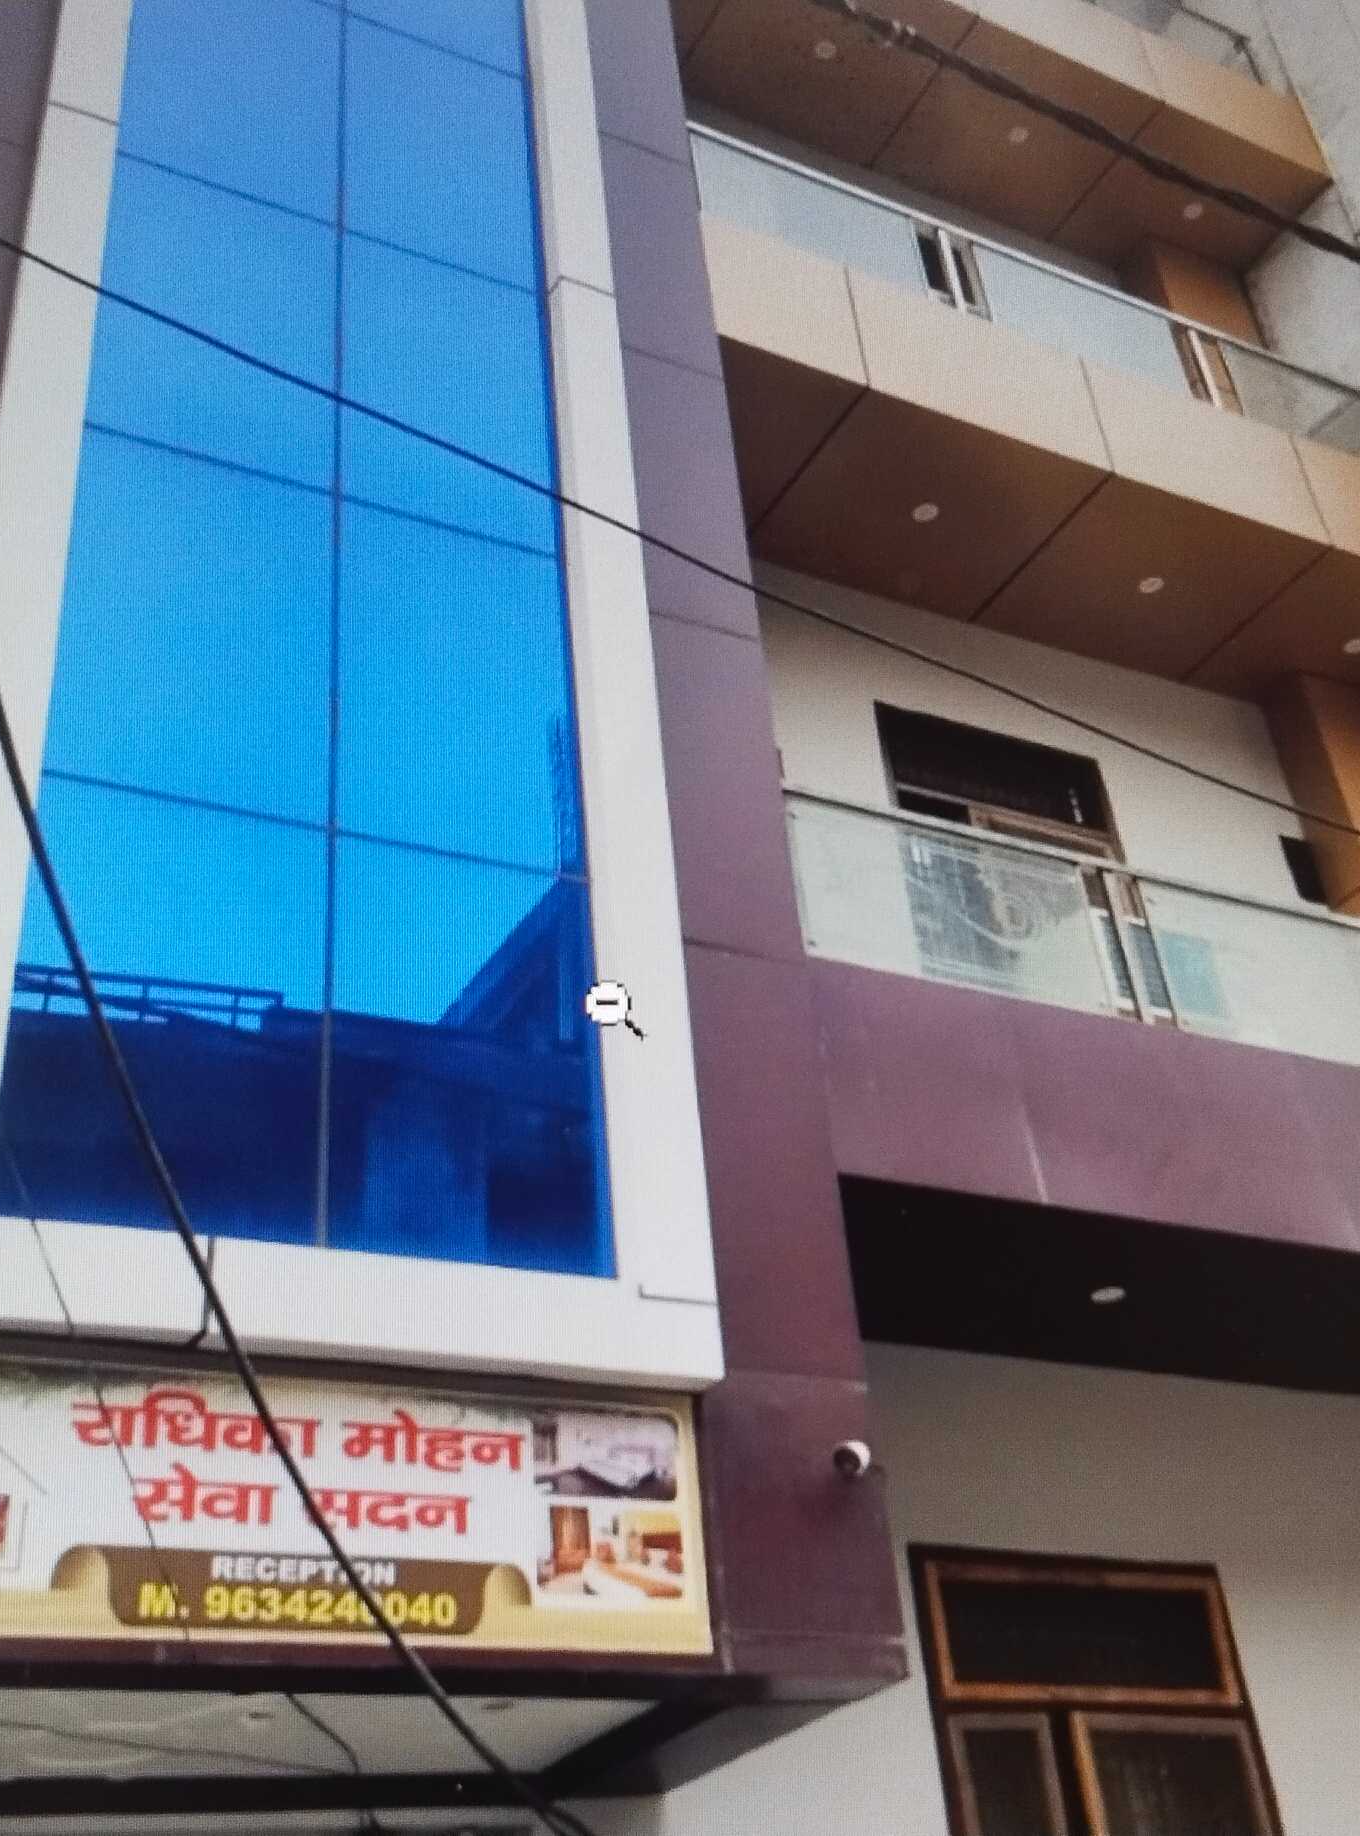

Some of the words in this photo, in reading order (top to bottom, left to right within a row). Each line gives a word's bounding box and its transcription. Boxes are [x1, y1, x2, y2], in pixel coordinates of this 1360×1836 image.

[73, 1388, 321, 1458] राधिका
[342, 1407, 526, 1472] मोहन
[133, 1462, 280, 1526] सेवा
[139, 1582, 190, 1620] M.
